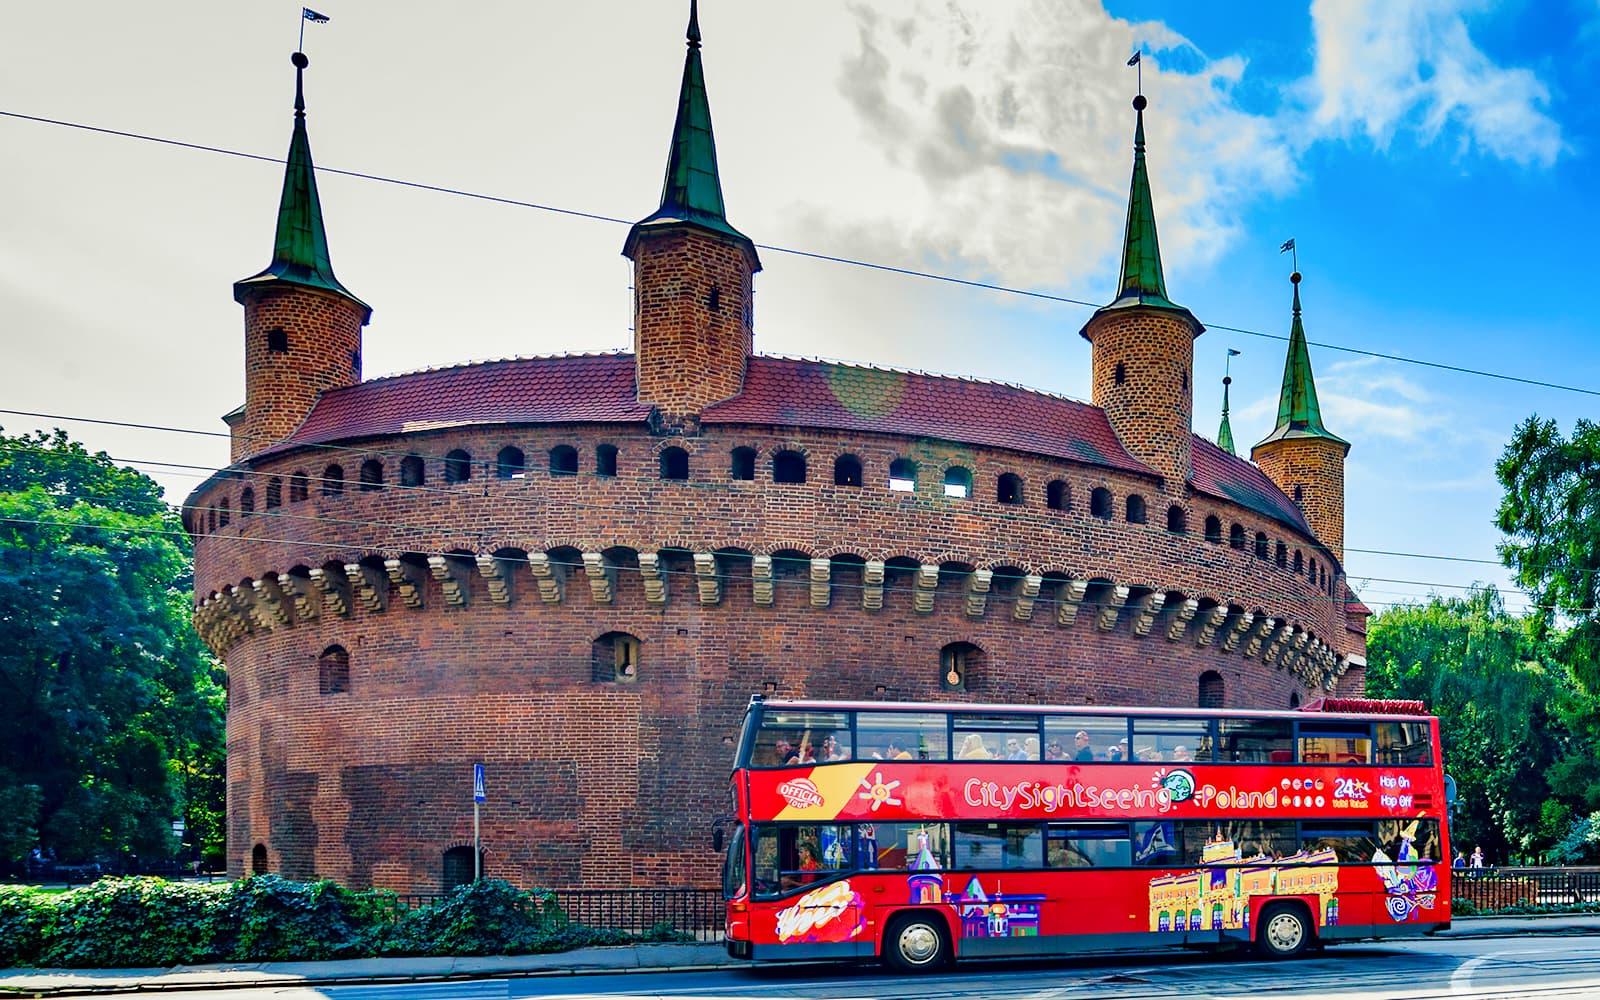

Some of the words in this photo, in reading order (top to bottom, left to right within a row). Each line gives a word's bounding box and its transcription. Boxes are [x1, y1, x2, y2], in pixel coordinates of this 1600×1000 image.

[1334, 777, 1353, 798] 24
[1379, 775, 1397, 788] Hop
[1398, 775, 1410, 788] On
[780, 783, 823, 806] OFFICIAL
[788, 797, 809, 808] TOUR
[1202, 784, 1277, 808] Poland
[1380, 794, 1398, 808] Hop
[1398, 794, 1413, 807] Off
